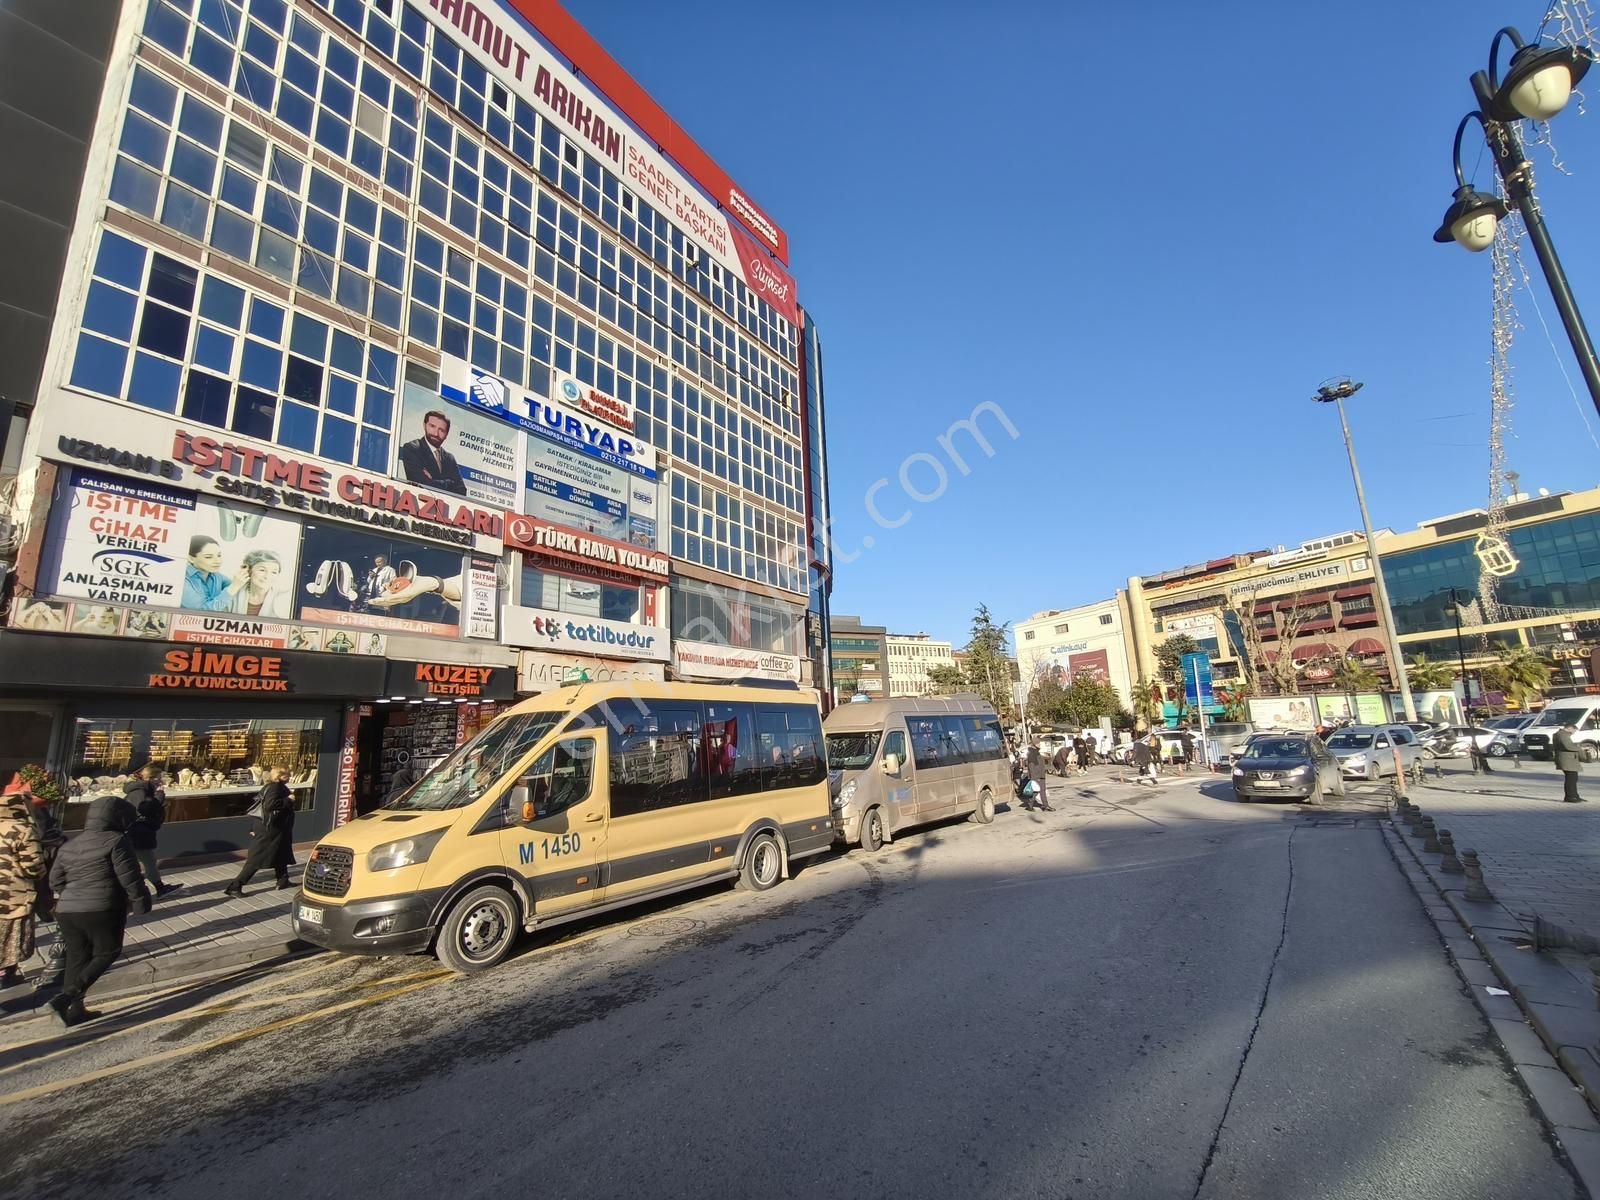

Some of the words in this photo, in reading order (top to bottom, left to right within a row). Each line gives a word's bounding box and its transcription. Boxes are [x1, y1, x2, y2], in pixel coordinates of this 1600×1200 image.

[429, 0, 530, 81] HMUT
[533, 64, 621, 163] ARIKAN
[629, 146, 680, 199] SAADET
[684, 195, 726, 241] PARTİSİ
[629, 163, 672, 209] GENEL
[676, 204, 726, 256] BAŞKANI
[524, 396, 633, 455] TURYAP
[58, 435, 153, 474] UZMAN
[460, 431, 514, 455] PROFESYONEL
[460, 440, 514, 463] DANIŞMANLIK
[547, 448, 573, 462] SATMAK
[482, 456, 514, 471] HİZMETİ
[601, 451, 617, 462] 0212
[618, 457, 628, 468] 217
[80, 478, 123, 492] ÇALIŞAN
[124, 486, 136, 495] ve
[136, 489, 193, 507] EMEKLİLERE
[172, 429, 325, 493] İŞİTME
[337, 474, 499, 537] CİHAZLARI
[470, 471, 494, 484] SELİM
[495, 479, 516, 490] URAL
[533, 474, 557, 488] SATILIK
[87, 490, 178, 523] İŞİTME
[214, 476, 277, 503] SATIŞ
[312, 497, 409, 533] UYGULAMA
[532, 482, 558, 496] KİRALIK
[568, 495, 594, 507] DÜKKAN
[89, 516, 168, 543] CİHAZI
[96, 533, 158, 553] VERİLİR
[534, 525, 577, 552] TÜRK
[579, 537, 616, 563] HAVA
[618, 548, 669, 576] YOLLARI
[100, 557, 151, 578] SGK
[1298, 565, 1341, 581] EHLİYET
[63, 571, 174, 595] ANLAŞMAMIZ
[88, 588, 148, 605] VARDIR
[203, 618, 263, 635] UZMAN
[336, 612, 376, 627] İŞİTME
[223, 636, 273, 648] CİHAZLARI
[565, 620, 655, 648] tatilbudur
[164, 646, 282, 677] SİMGE
[703, 655, 725, 667] BURADA
[760, 655, 783, 669] coffee
[148, 673, 288, 691] KUYUMCULUK
[416, 663, 494, 685] KUZEY
[428, 683, 480, 696] İLETİŞİM
[343, 735, 356, 765] %50
[337, 767, 355, 828] İNDİRİM
[519, 841, 534, 865] M
[541, 832, 581, 859] 1450
